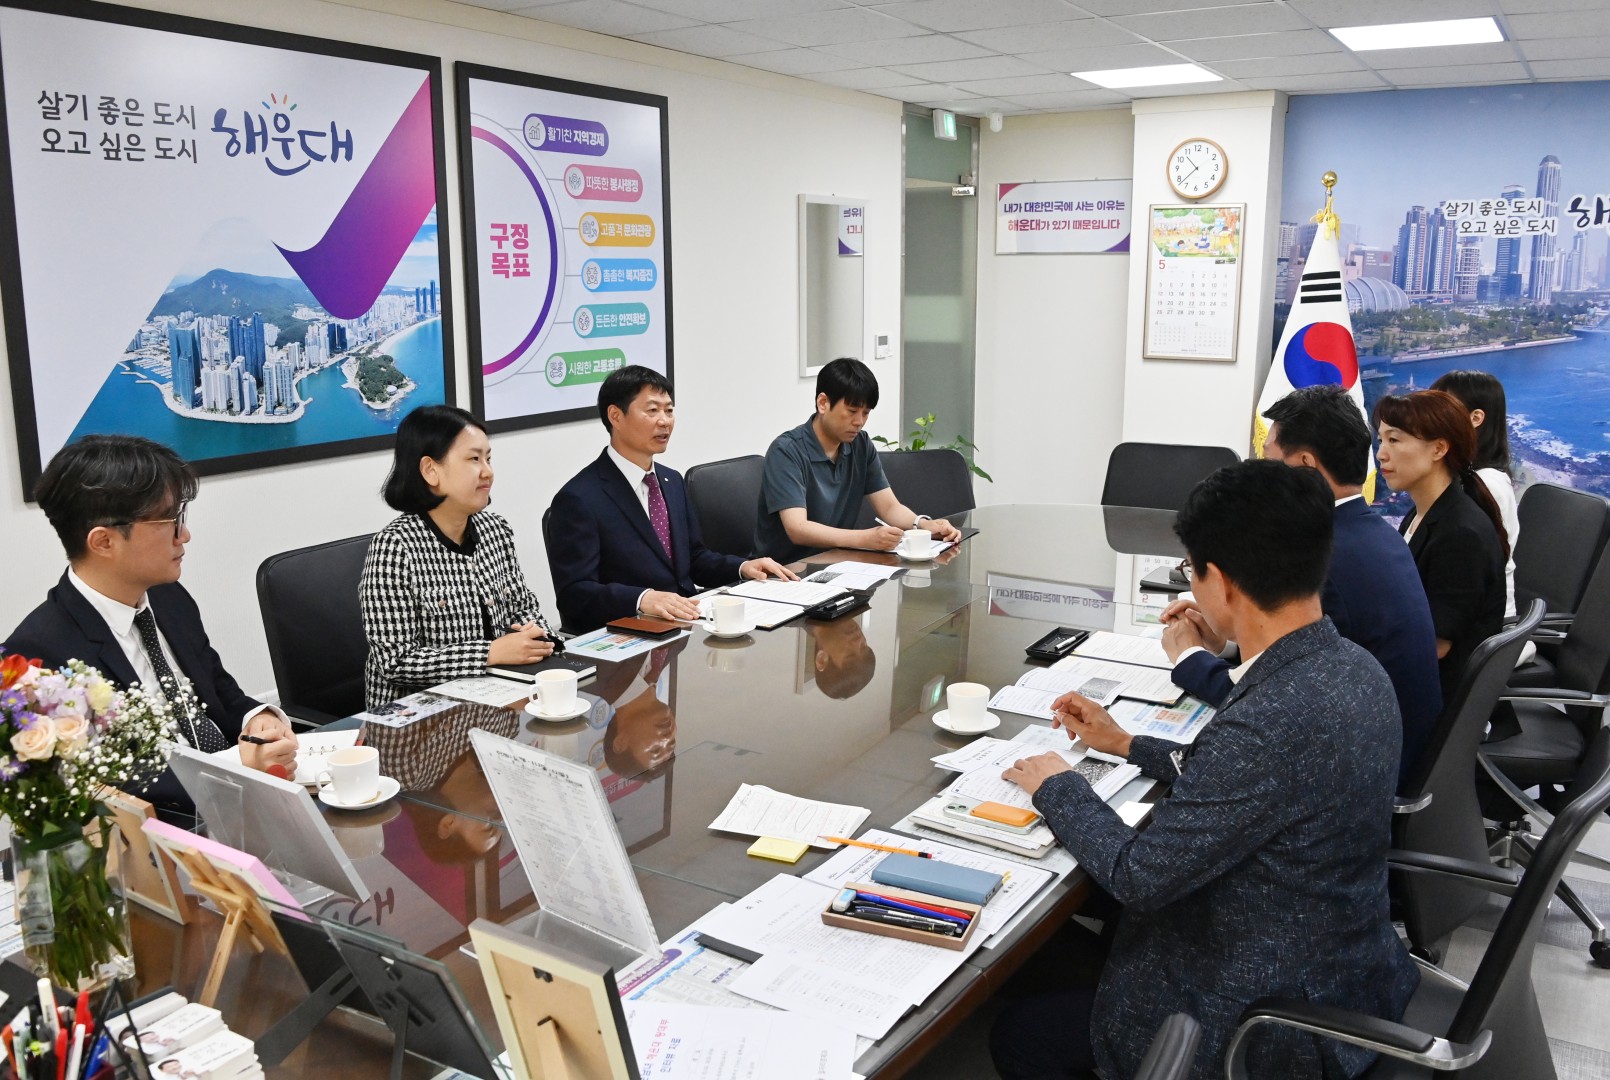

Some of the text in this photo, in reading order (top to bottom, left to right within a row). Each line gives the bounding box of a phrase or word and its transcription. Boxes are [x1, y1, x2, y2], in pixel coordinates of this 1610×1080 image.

[37, 90, 196, 130] 살기 좋은 도시
[210, 107, 353, 176] 해운대
[547, 126, 606, 147] 활기찬 지역경제
[41, 128, 198, 163] 오고 싶은 도시
[1194, 144, 1202, 152] 12
[586, 175, 639, 193] 따뜻한 봉사행정
[1004, 199, 1125, 214] 내가 대한민국에 사는 이유는
[1445, 200, 1541, 217] 살기 좋은 도시
[601, 223, 652, 238] 고품격 문화관광
[1007, 219, 1121, 231] 해운대가 있기 때문입니다
[1459, 219, 1555, 235] 오고 싶은 도시
[490, 223, 530, 250] 구정
[491, 252, 531, 279] 목표
[1158, 259, 1166, 270] 5
[603, 268, 654, 283] 촘촘한 복지증진
[595, 313, 647, 328] 든든한 안전확보
[568, 361, 592, 376] 시원한
